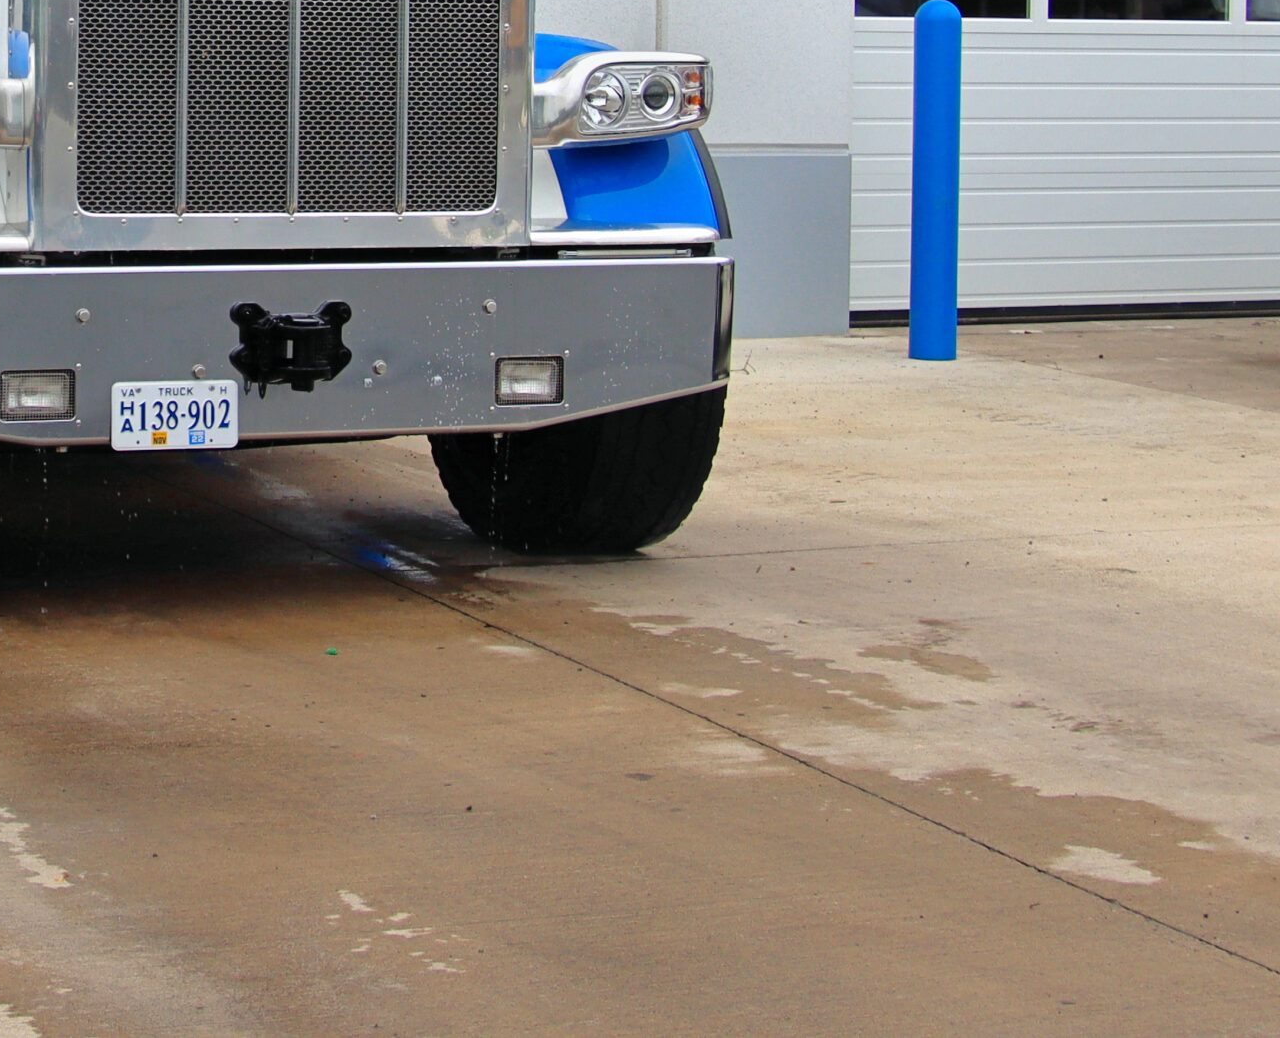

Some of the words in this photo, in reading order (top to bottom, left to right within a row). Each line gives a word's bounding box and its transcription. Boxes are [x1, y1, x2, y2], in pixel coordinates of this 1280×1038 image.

[121, 389, 135, 397] VA
[158, 387, 194, 396] TRUCK
[138, 399, 231, 431] 138-902
[191, 435, 204, 443] 22
